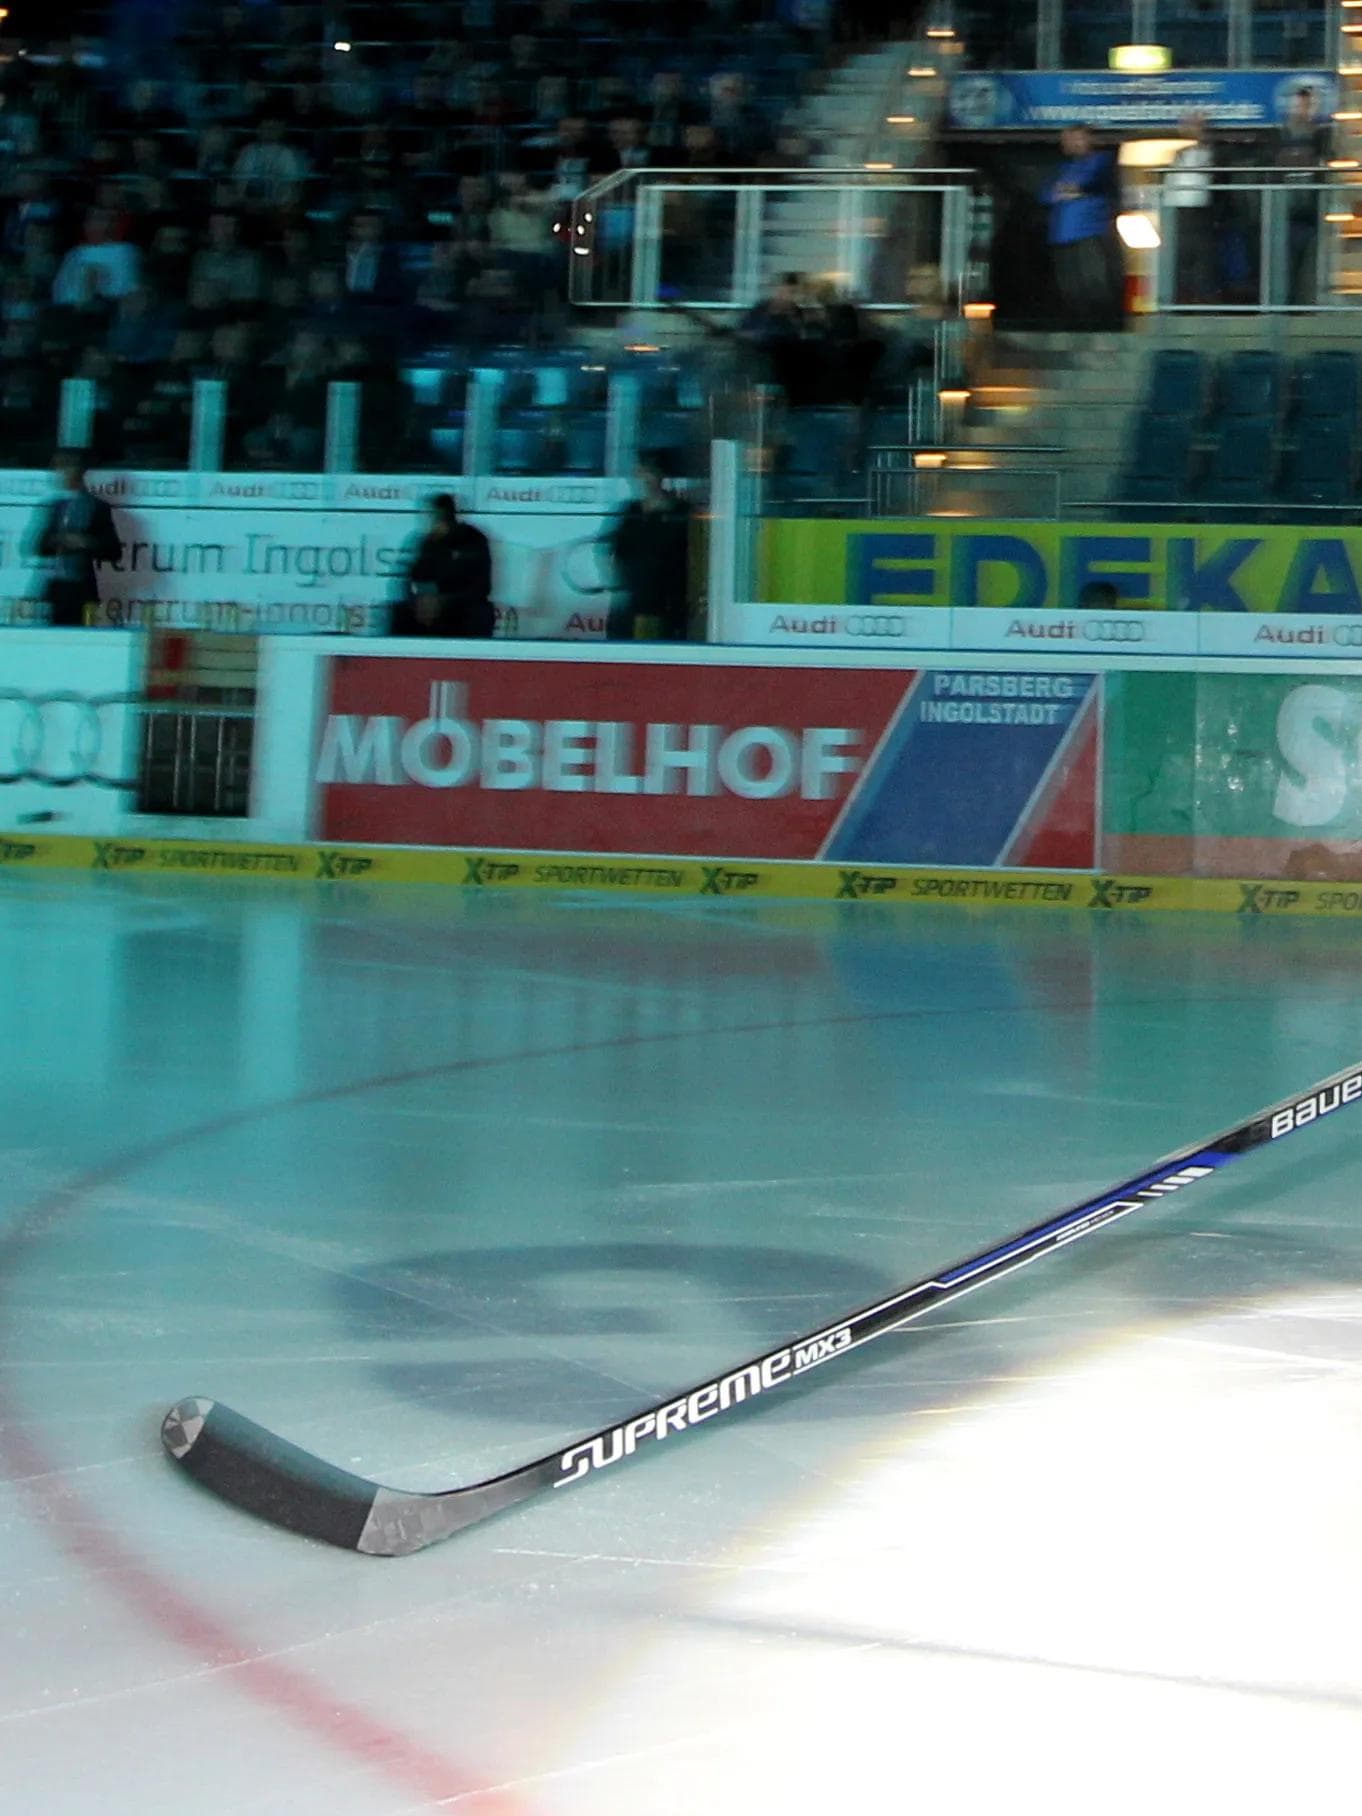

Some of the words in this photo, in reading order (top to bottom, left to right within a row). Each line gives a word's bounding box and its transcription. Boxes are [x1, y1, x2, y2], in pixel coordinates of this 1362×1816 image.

[244, 533, 402, 588] Ingols
[769, 615, 837, 635] Audi
[1004, 619, 1077, 640] Audi
[1254, 624, 1324, 644] Audi
[934, 674, 1073, 698] PARSBERG
[920, 701, 1059, 725] INGOLSTADT
[317, 680, 864, 799] MÖBELHOF
[532, 864, 683, 888] SPORTWETTEN
[911, 878, 1073, 902] SPORTWETTEN
[553, 1348, 793, 1489] SUPREME
[794, 1327, 852, 1369] MX3
